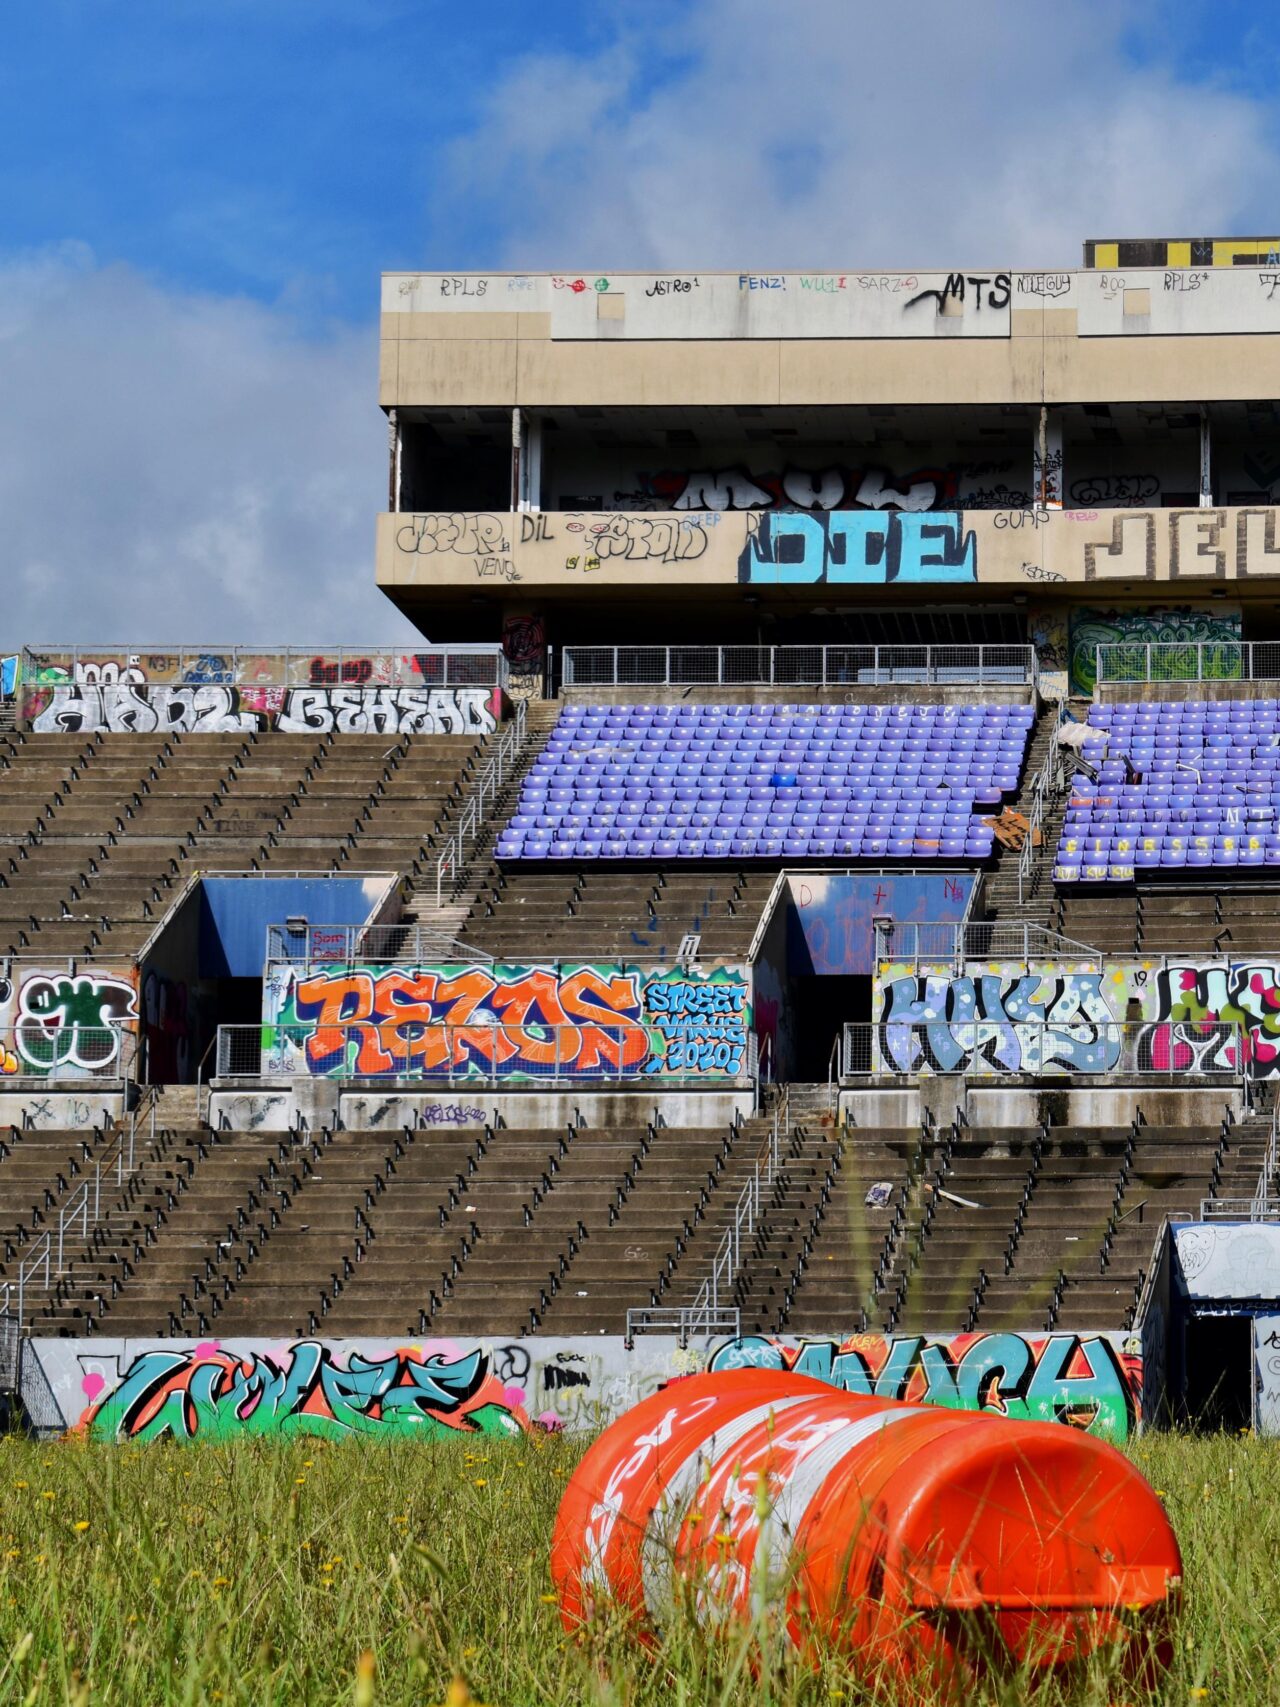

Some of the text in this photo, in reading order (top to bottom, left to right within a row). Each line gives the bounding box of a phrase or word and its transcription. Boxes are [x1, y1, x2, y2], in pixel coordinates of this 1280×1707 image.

[440, 278, 488, 296] RPLS
[738, 276, 787, 291] FENZ!
[993, 509, 1051, 530] GUAP
[645, 982, 749, 1012] STREET
